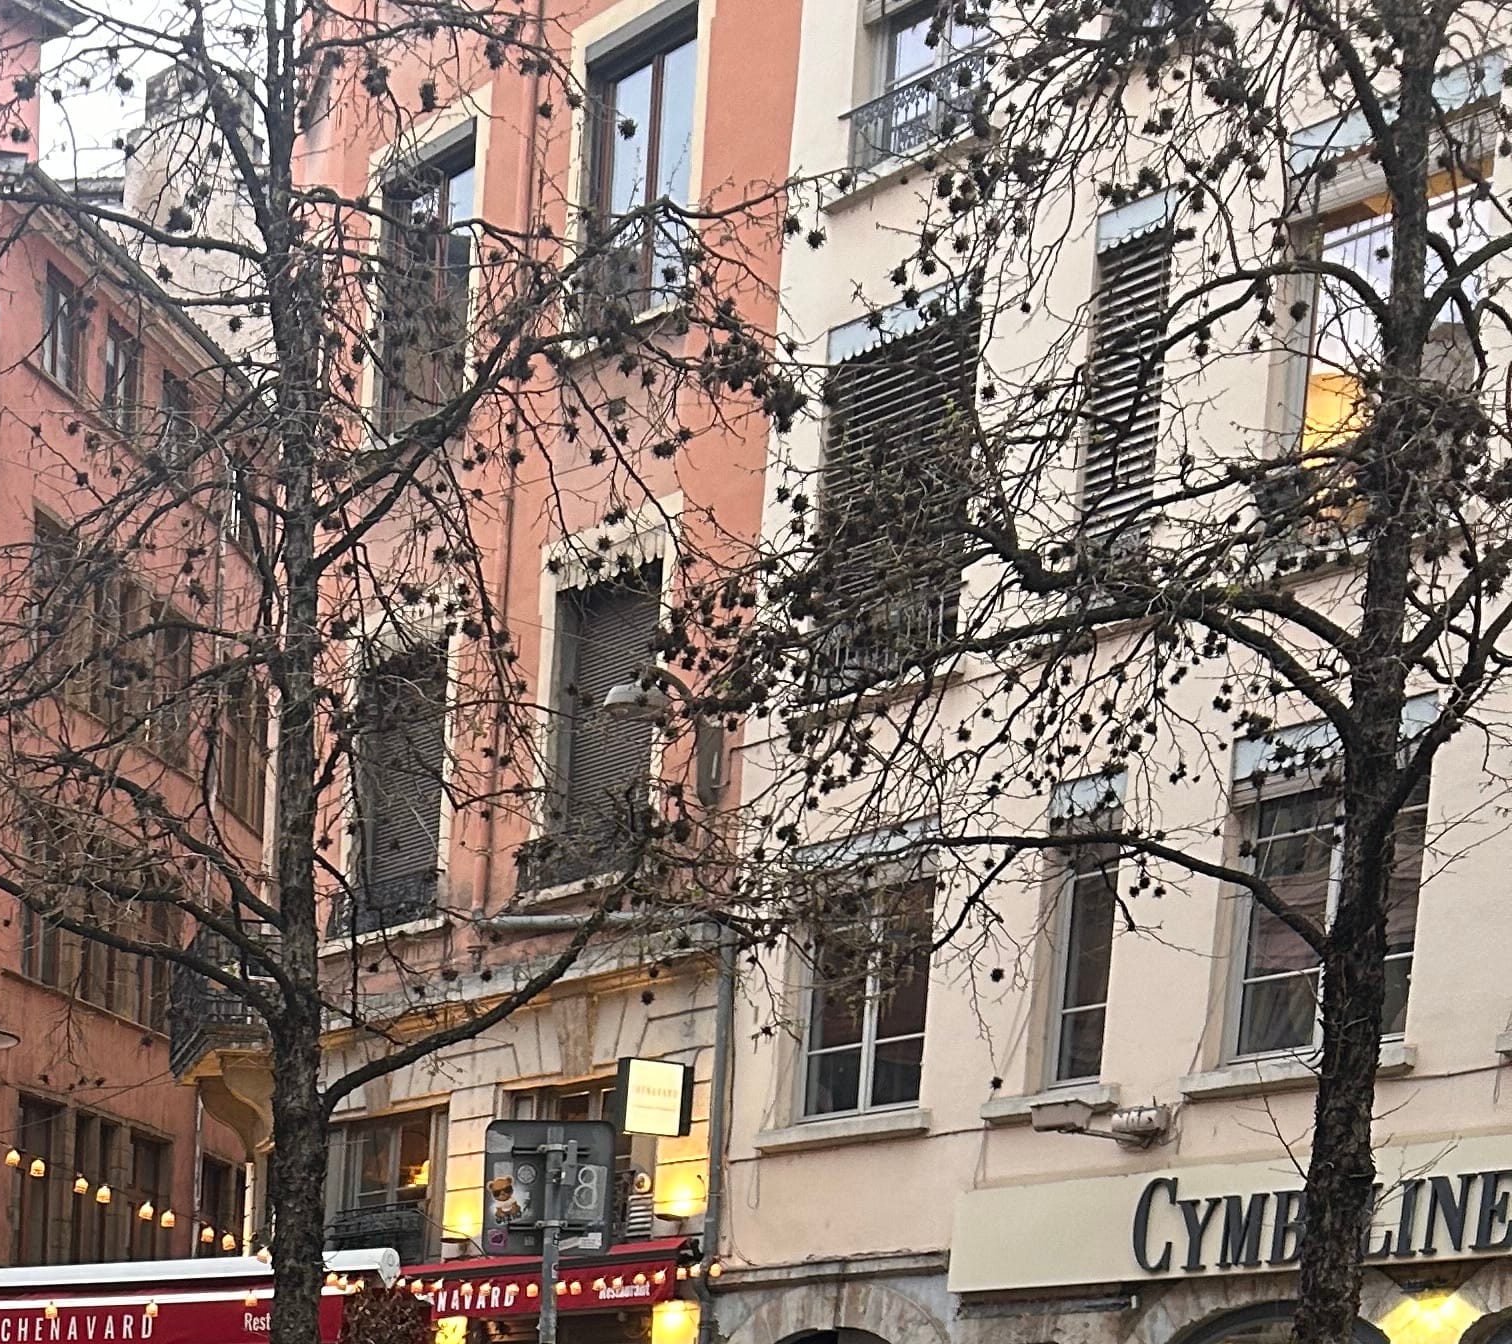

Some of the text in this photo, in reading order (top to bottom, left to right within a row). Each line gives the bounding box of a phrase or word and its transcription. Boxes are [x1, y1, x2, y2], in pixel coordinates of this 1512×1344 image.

[1133, 1168, 1512, 1273] CYMBLINE
[0, 1314, 154, 1343] CHENAVARD
[244, 1312, 272, 1332] Rest
